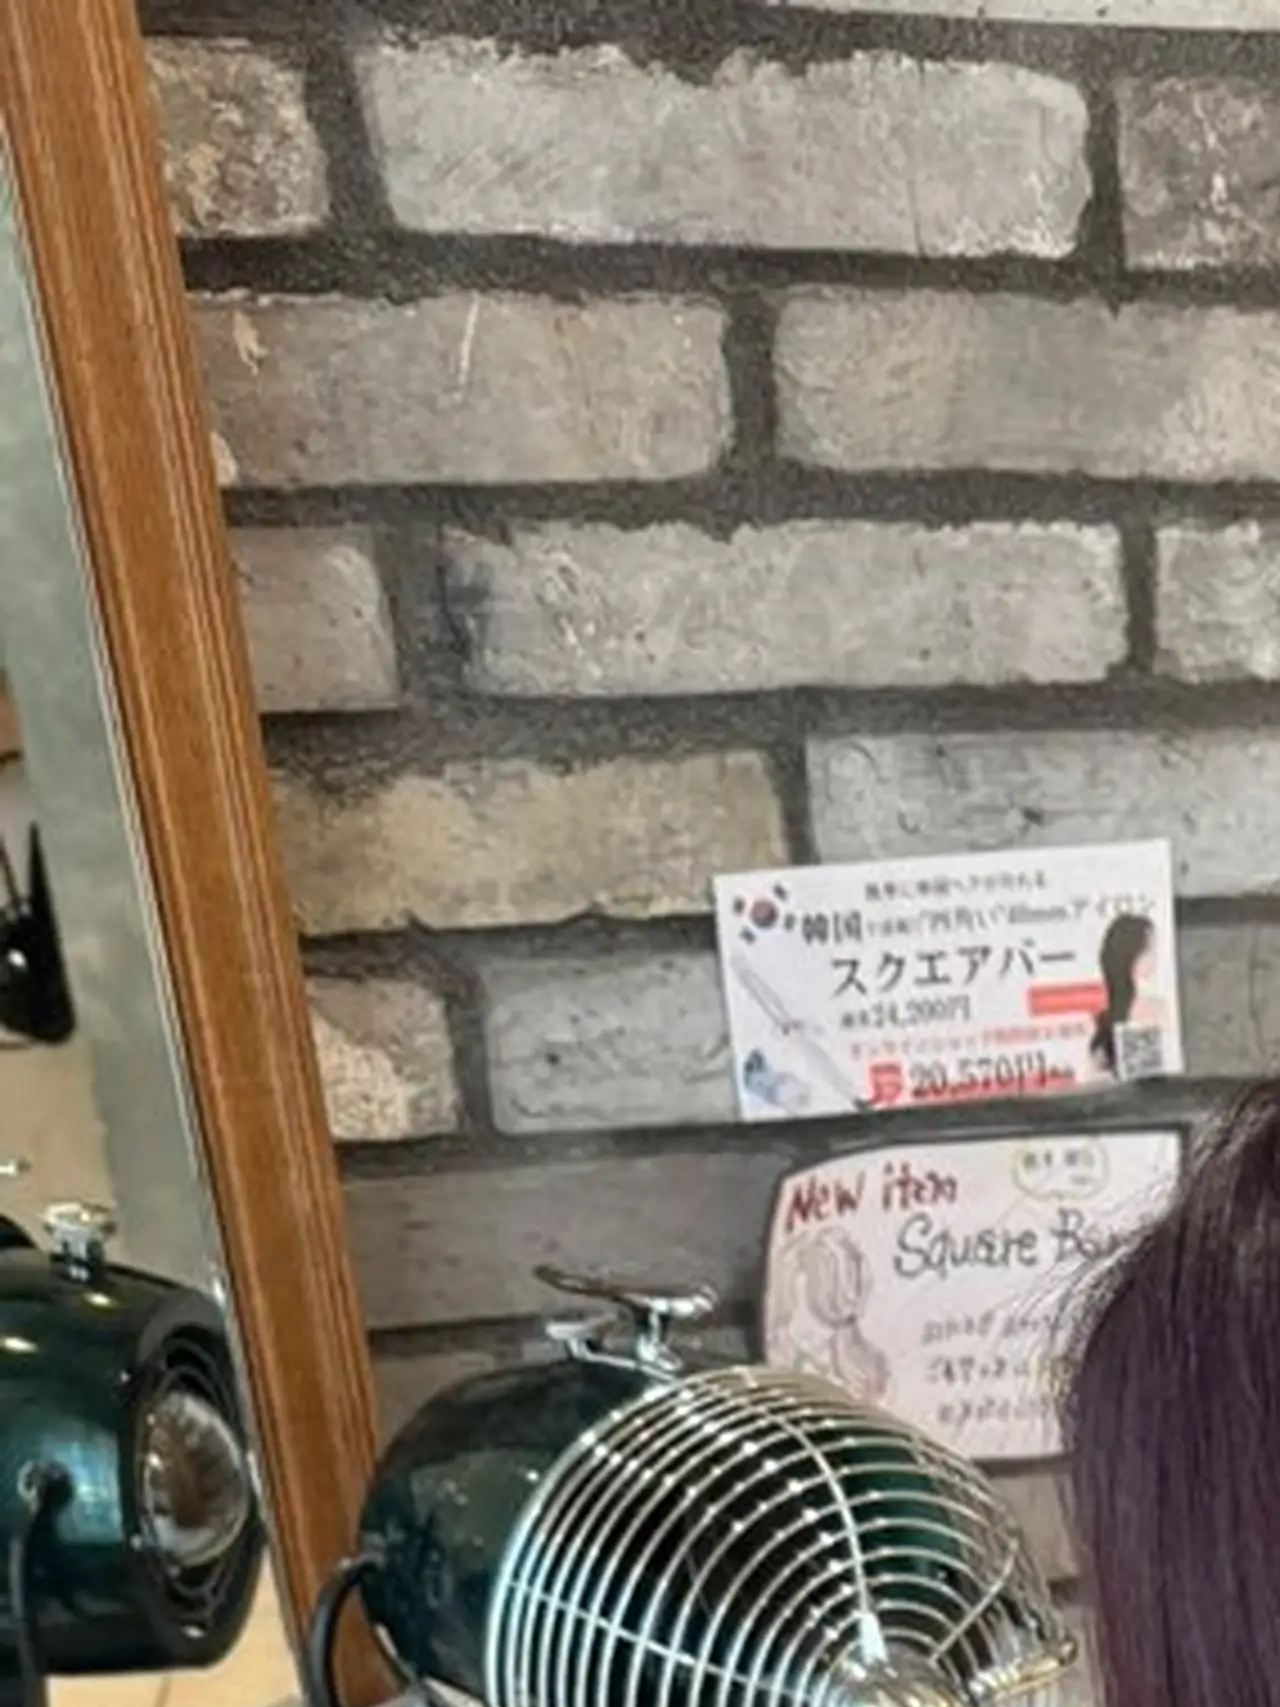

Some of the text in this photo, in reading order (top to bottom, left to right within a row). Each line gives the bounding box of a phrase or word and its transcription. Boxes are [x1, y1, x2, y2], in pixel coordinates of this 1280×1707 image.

[830, 937, 1076, 996] スクエアバー
[784, 1172, 866, 1232] New
[882, 1160, 960, 1213] item
[894, 1212, 1038, 1280] Square
